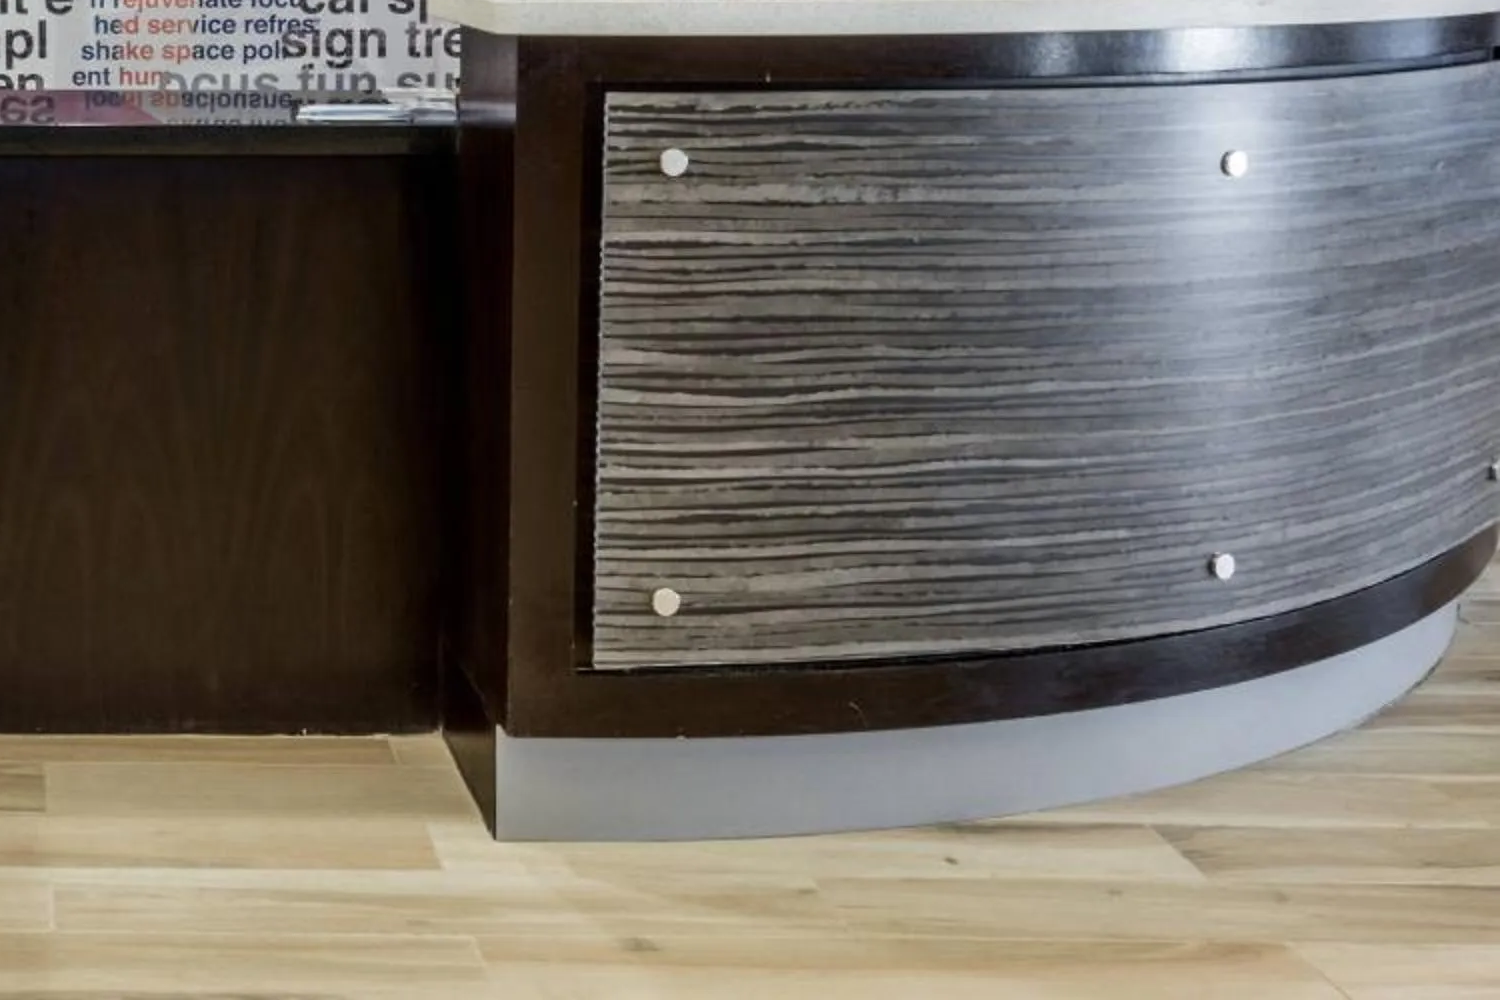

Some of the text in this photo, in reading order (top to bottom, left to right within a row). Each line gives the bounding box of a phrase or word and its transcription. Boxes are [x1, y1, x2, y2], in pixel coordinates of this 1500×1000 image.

[95, 15, 314, 34] hed service refres
[81, 42, 153, 62] shake
[162, 45, 235, 65] space
[281, 27, 386, 68] sign
[72, 68, 111, 86] ent
